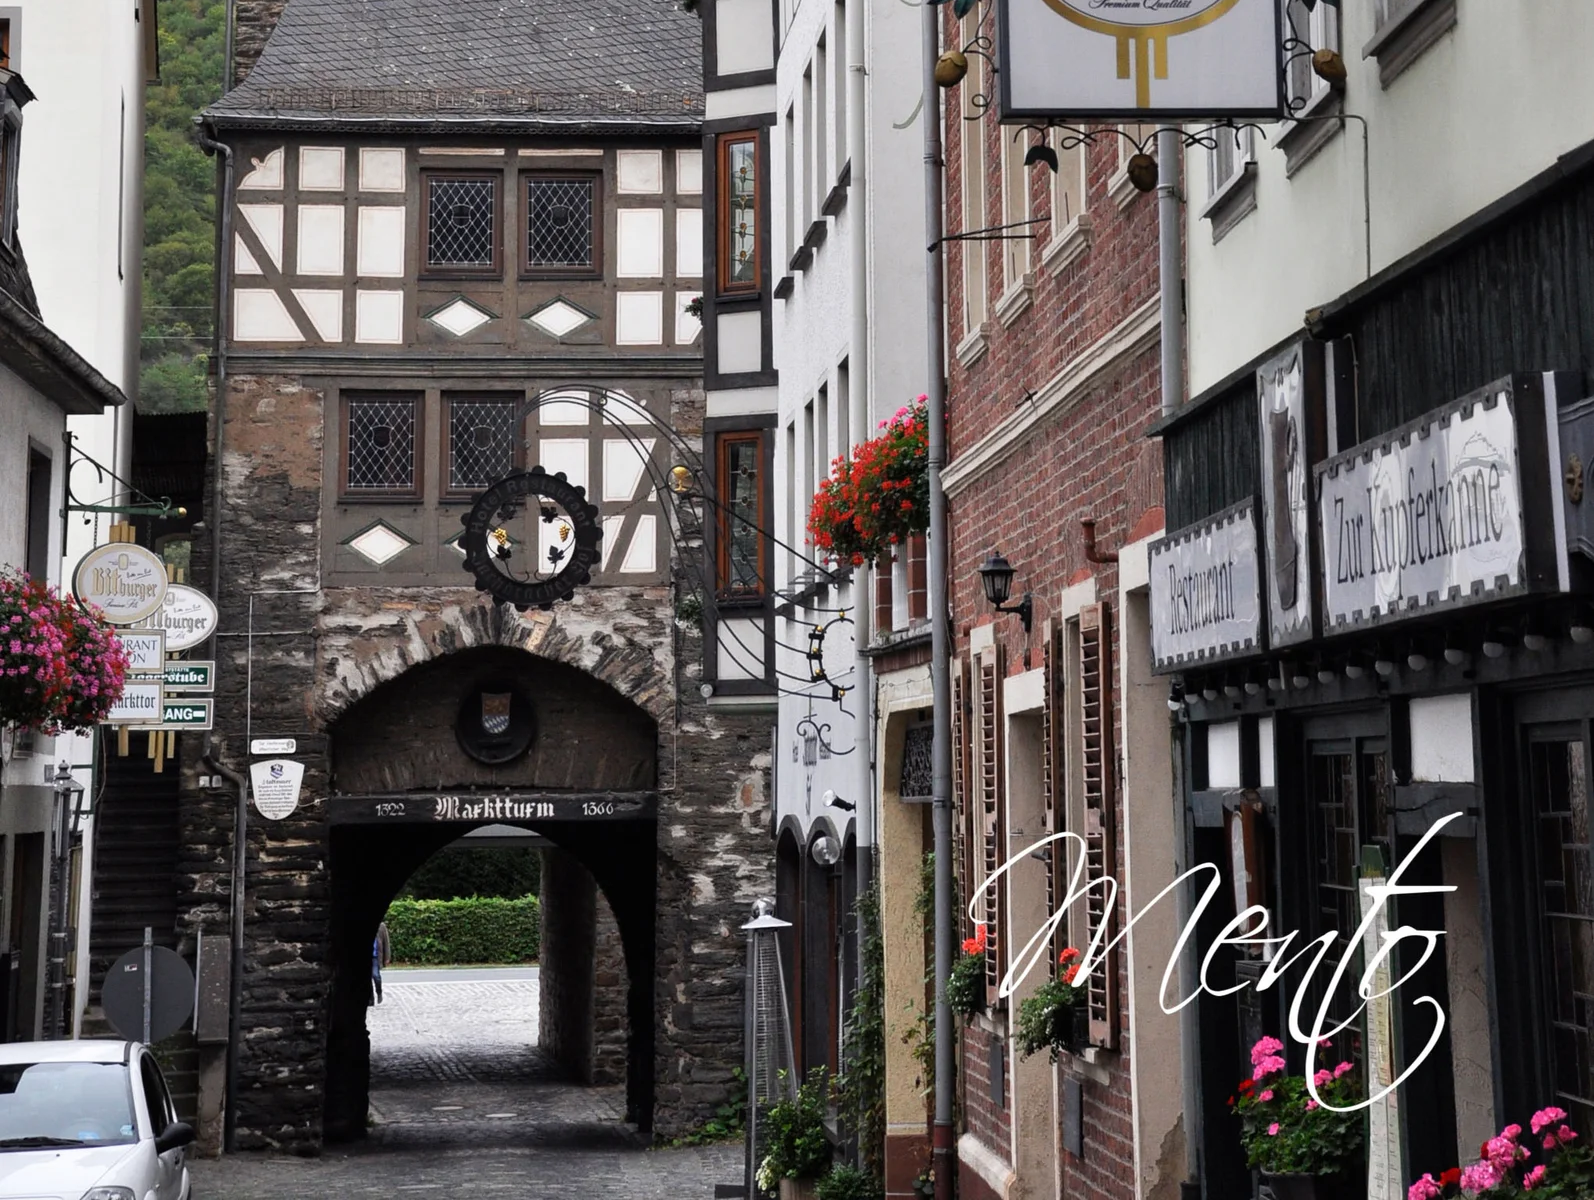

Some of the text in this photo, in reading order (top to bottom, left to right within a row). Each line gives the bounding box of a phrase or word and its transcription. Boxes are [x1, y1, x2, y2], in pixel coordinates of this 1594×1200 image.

[1334, 457, 1503, 601] Zur Kupferkanne
[92, 567, 158, 602] Bitburger
[1168, 550, 1235, 636] Restaurant
[122, 639, 158, 651] URANT
[112, 692, 156, 709] arkttor
[163, 708, 193, 720] ANG
[434, 796, 555, 820] Marktturm
